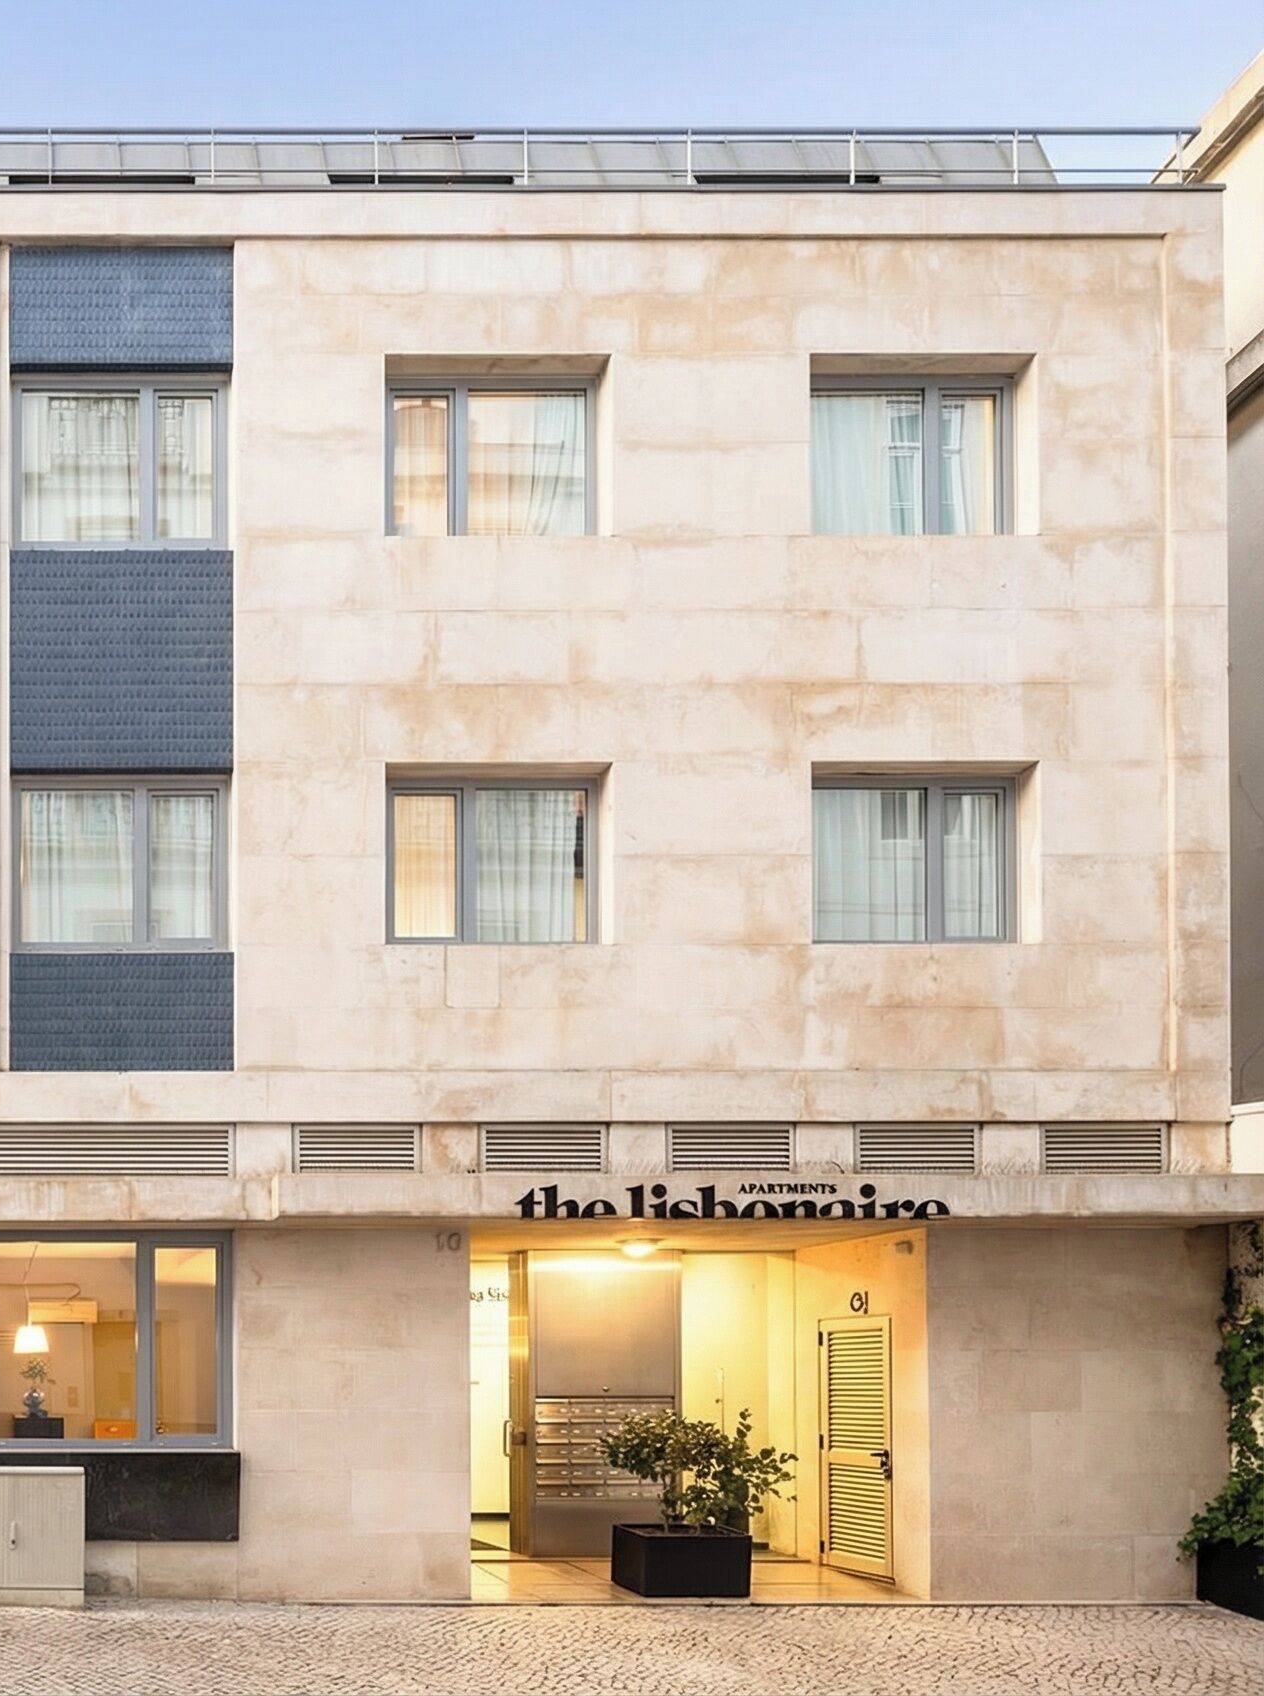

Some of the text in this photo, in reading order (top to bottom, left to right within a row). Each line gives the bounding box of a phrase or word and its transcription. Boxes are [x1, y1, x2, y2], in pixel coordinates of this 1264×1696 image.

[738, 1183, 838, 1195] APARTMENTS
[514, 1183, 951, 1220] the lisbonaire
